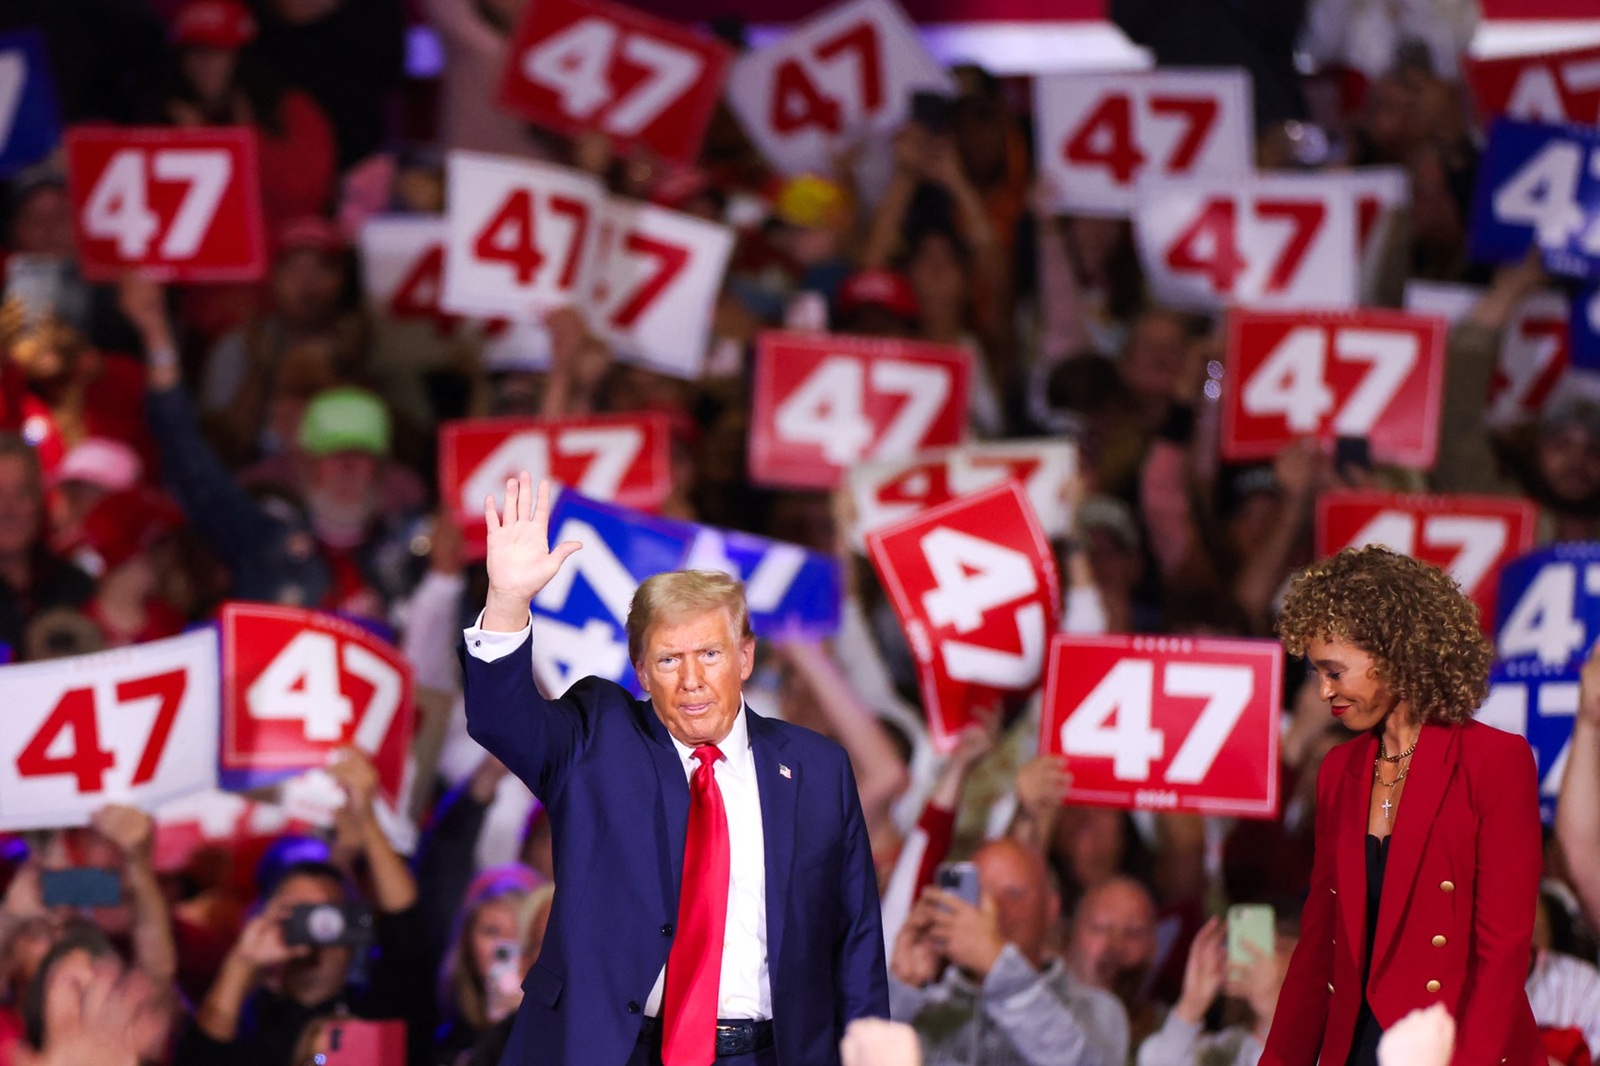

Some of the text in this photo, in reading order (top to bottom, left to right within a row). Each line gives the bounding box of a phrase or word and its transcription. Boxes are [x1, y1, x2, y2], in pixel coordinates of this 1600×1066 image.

[523, 18, 704, 136] 47
[767, 22, 883, 137] 47
[1062, 92, 1221, 186] 47
[81, 148, 234, 260] 47
[472, 187, 588, 291] 47
[1165, 196, 1328, 296] 47
[1490, 138, 1600, 257] 4
[774, 355, 953, 468] 47
[1242, 326, 1420, 438] 47
[461, 424, 646, 518] 47
[917, 524, 1048, 690] 47
[1496, 560, 1600, 670] 4
[14, 668, 188, 796] 47
[244, 628, 402, 759] 47
[1060, 657, 1256, 785] 47
